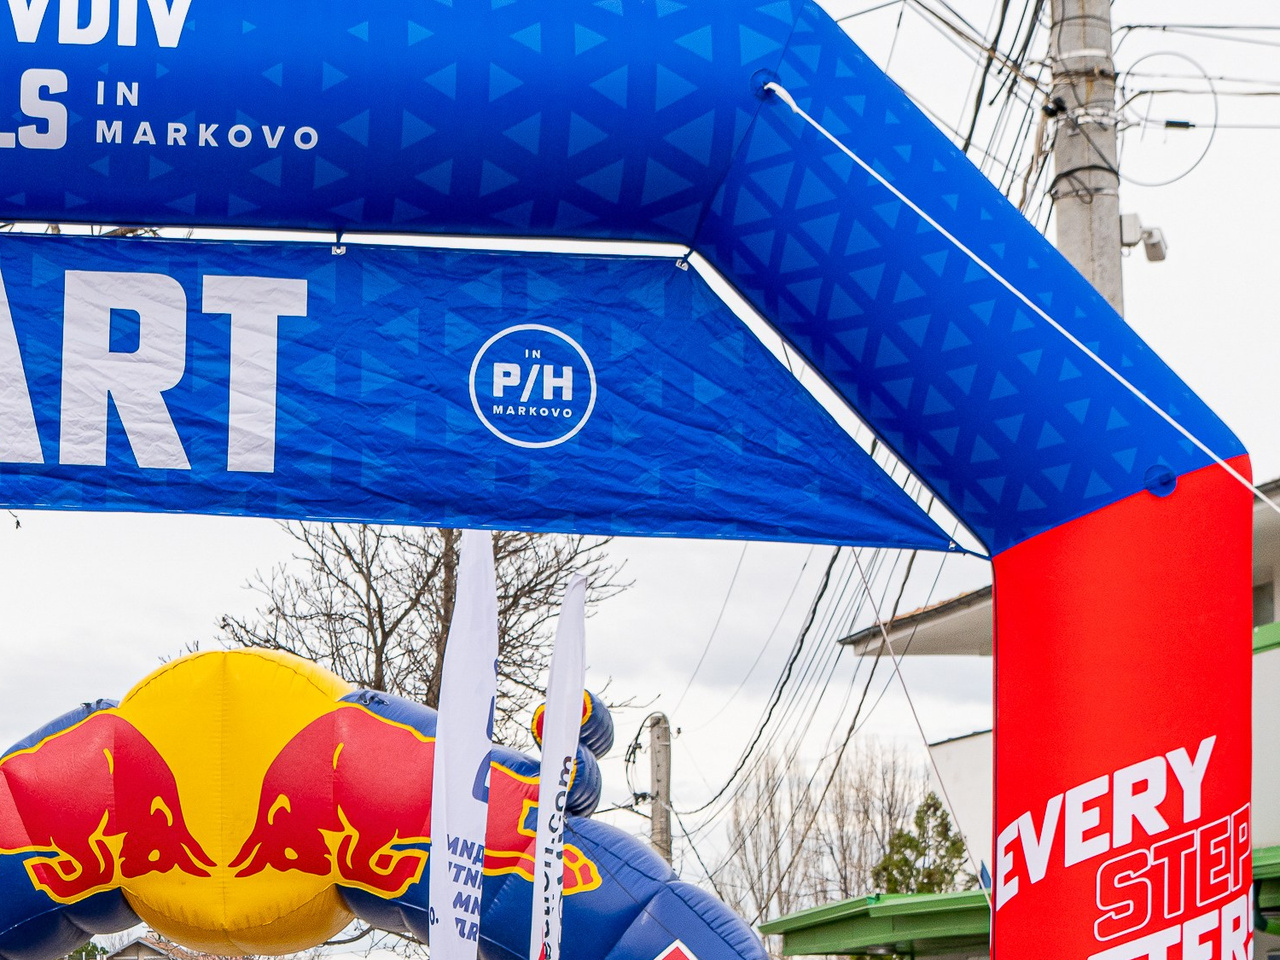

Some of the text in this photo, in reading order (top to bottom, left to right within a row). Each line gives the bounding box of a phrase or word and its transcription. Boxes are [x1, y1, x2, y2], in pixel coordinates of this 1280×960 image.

[95, 80, 139, 107] IN
[95, 119, 319, 150] MARKOVO
[524, 348, 541, 359] IN
[491, 362, 574, 402] P/H
[491, 404, 573, 418] MARKOVO
[996, 735, 1217, 912] EVERY
[1094, 801, 1252, 942] STEP
